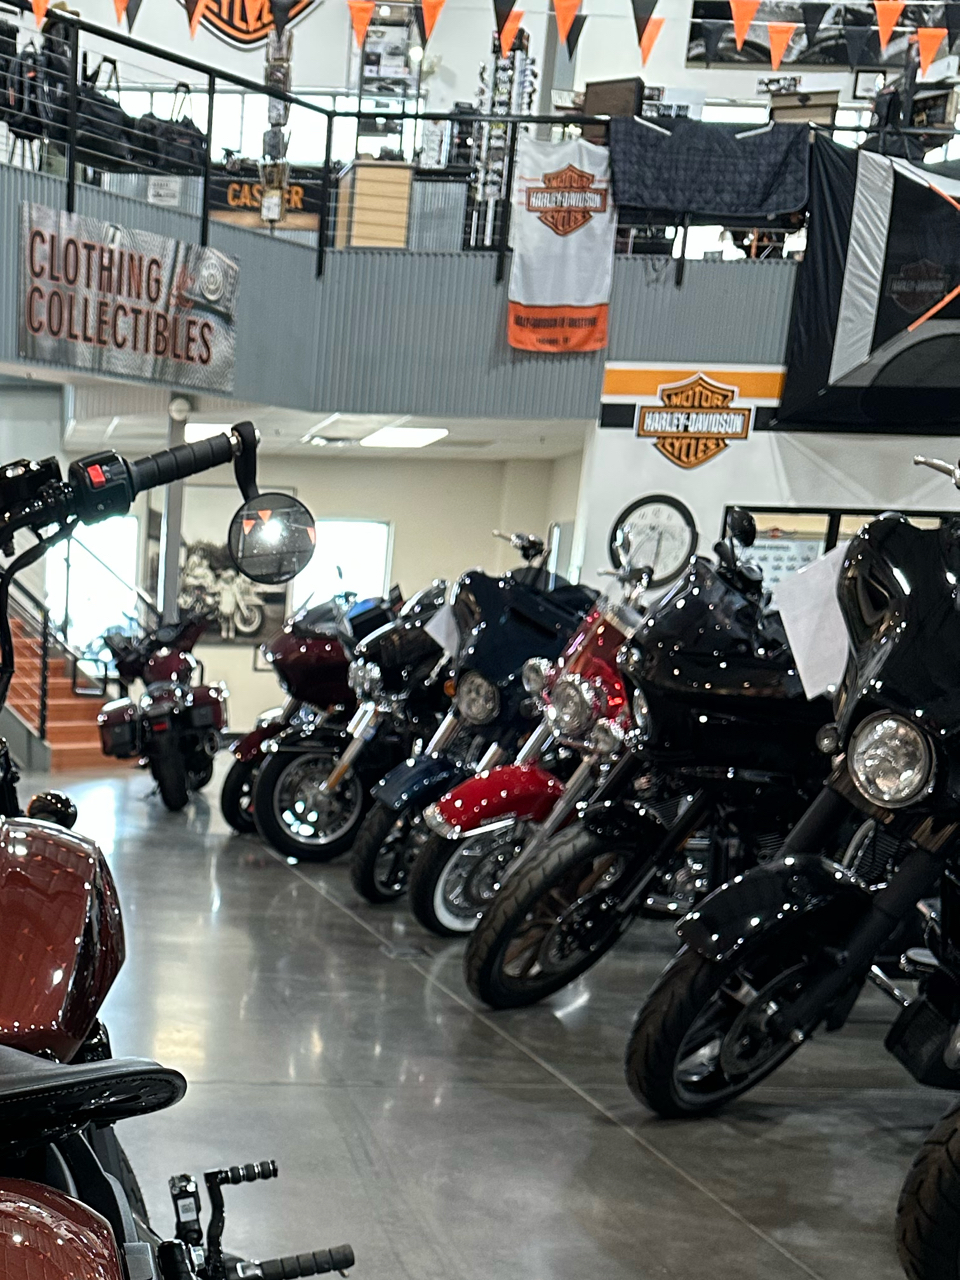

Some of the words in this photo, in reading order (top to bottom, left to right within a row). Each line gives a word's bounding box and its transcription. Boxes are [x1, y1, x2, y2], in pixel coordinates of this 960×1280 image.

[226, 182, 304, 209] CASER
[28, 228, 162, 304] CLOTHING
[26, 284, 214, 365] COLLECTIBLES
[670, 385, 723, 408] MOTOR
[643, 411, 745, 434] HARLEY-DAVIDSON
[663, 438, 719, 463] CYCLES
